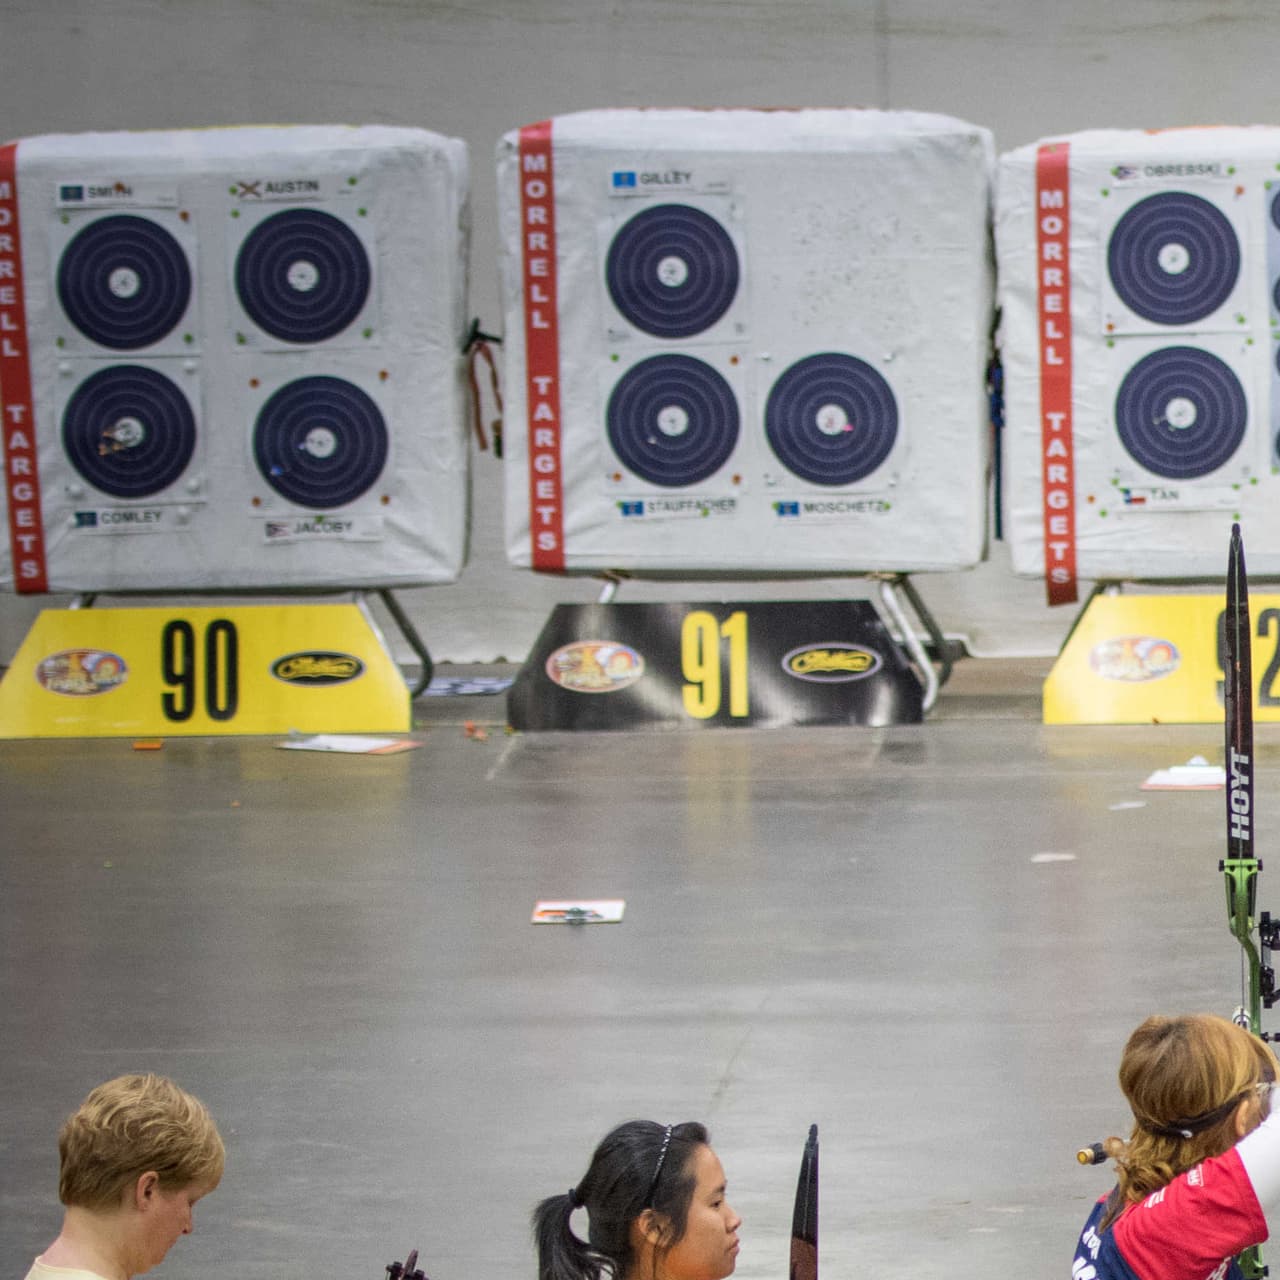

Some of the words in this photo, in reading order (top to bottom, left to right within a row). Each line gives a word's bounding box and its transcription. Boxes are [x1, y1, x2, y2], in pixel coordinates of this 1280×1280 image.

[265, 180, 320, 195] AUSTIN
[640, 172, 692, 185] GILLEY
[524, 155, 549, 329] MORRELL
[1040, 190, 1063, 364] MORRELL
[6, 404, 39, 579] TARGETS
[533, 377, 556, 551] TARGETS
[1045, 412, 1069, 585] TARGETS
[1150, 489, 1180, 501] TAN
[101, 511, 162, 525] COMLEY
[294, 519, 352, 536] JACOBY
[161, 618, 240, 722] 90
[681, 611, 750, 720] 91
[1231, 746, 1250, 841] HOYT
